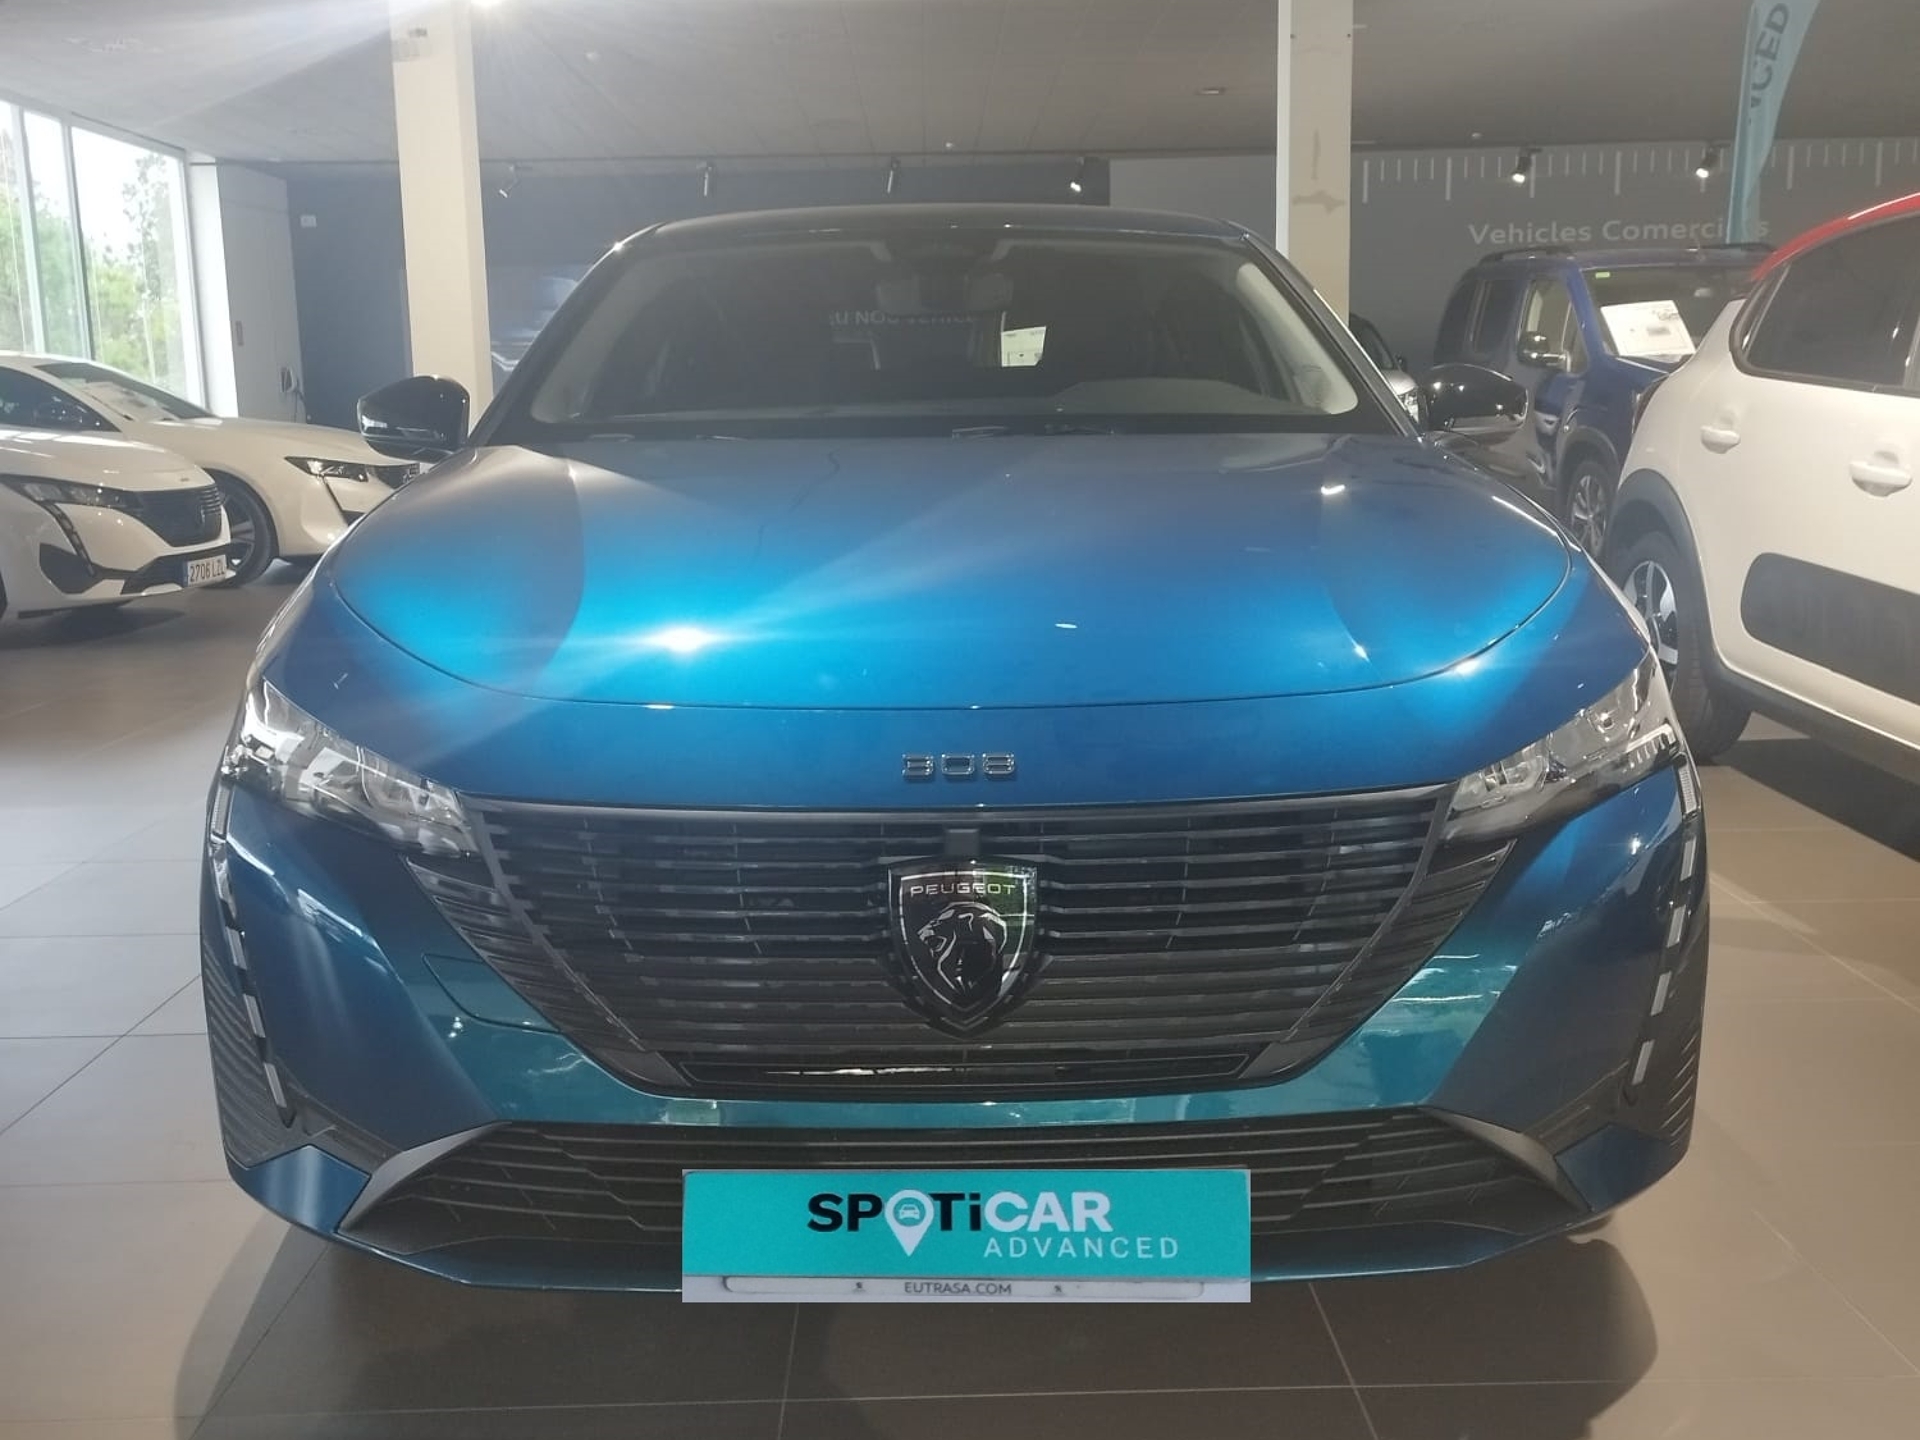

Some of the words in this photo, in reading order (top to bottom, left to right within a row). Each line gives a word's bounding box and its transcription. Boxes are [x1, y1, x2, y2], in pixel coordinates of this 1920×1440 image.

[1468, 222, 1592, 245] Vehicles
[1602, 218, 1769, 241] Comercis
[190, 563, 211, 582] 2706
[902, 753, 1016, 777] 308
[910, 883, 1016, 898] PEUGEOT
